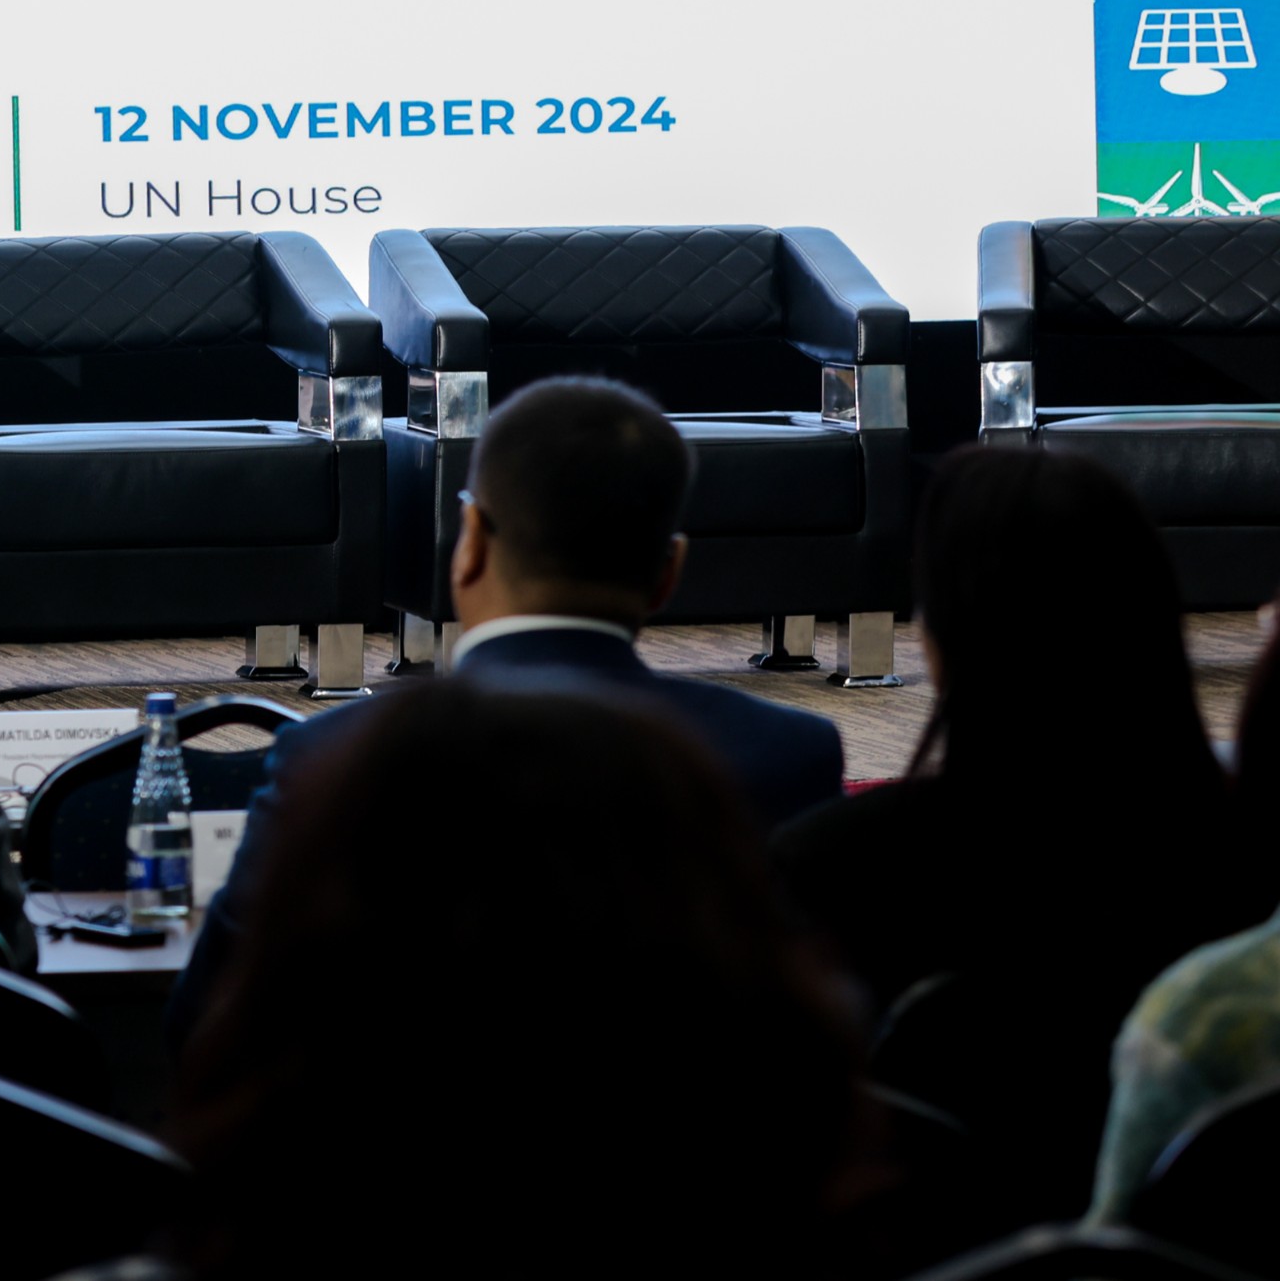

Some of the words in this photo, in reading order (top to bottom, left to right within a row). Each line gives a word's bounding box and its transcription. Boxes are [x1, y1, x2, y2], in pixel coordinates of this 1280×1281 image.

[94, 105, 151, 144] 12
[172, 99, 517, 143] NOVEMBER
[536, 96, 678, 136] 2024
[101, 181, 182, 221] UN
[208, 178, 384, 219] House
